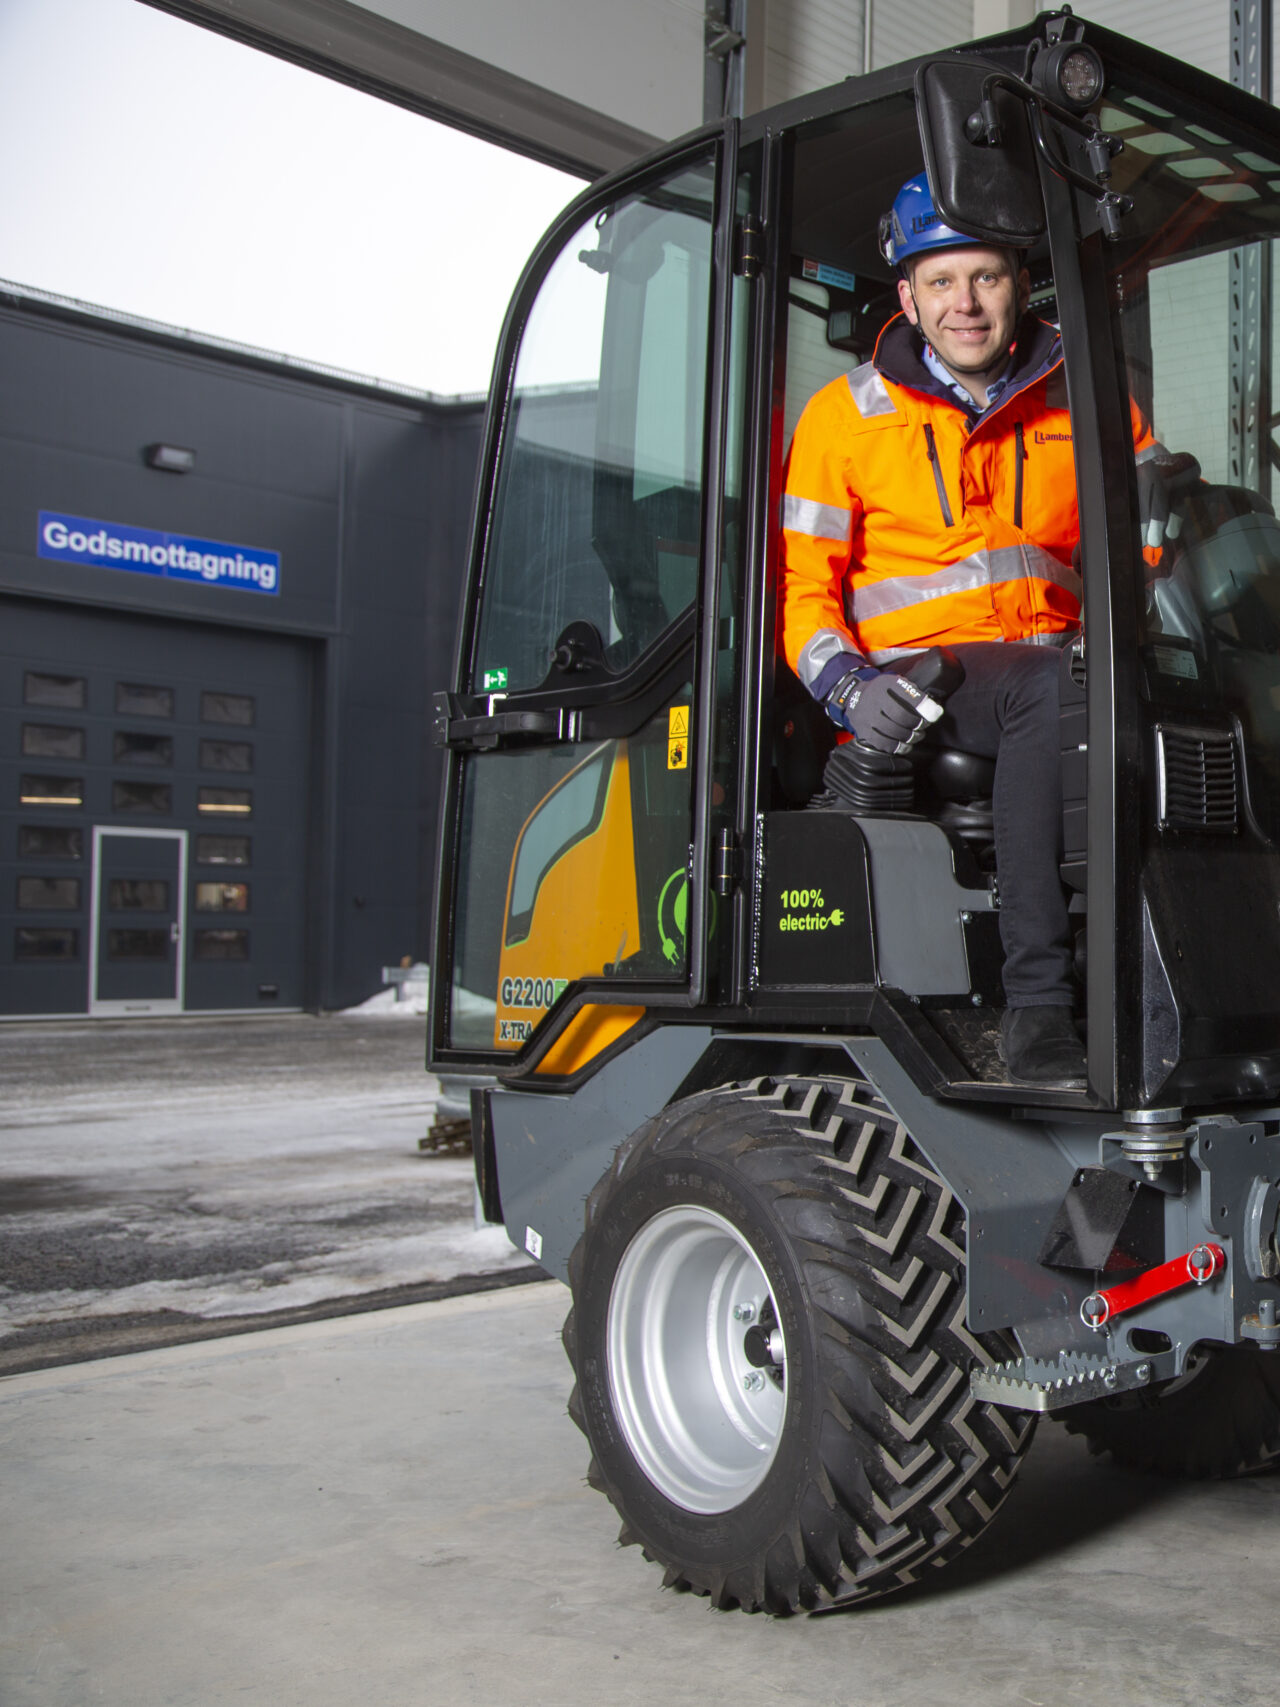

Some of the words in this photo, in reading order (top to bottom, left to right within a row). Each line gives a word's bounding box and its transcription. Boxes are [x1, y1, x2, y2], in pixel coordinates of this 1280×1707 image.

[43, 521, 277, 589] Godsmottagning
[896, 678, 920, 698] water
[780, 889, 824, 908] 100%
[779, 912, 827, 931] electric
